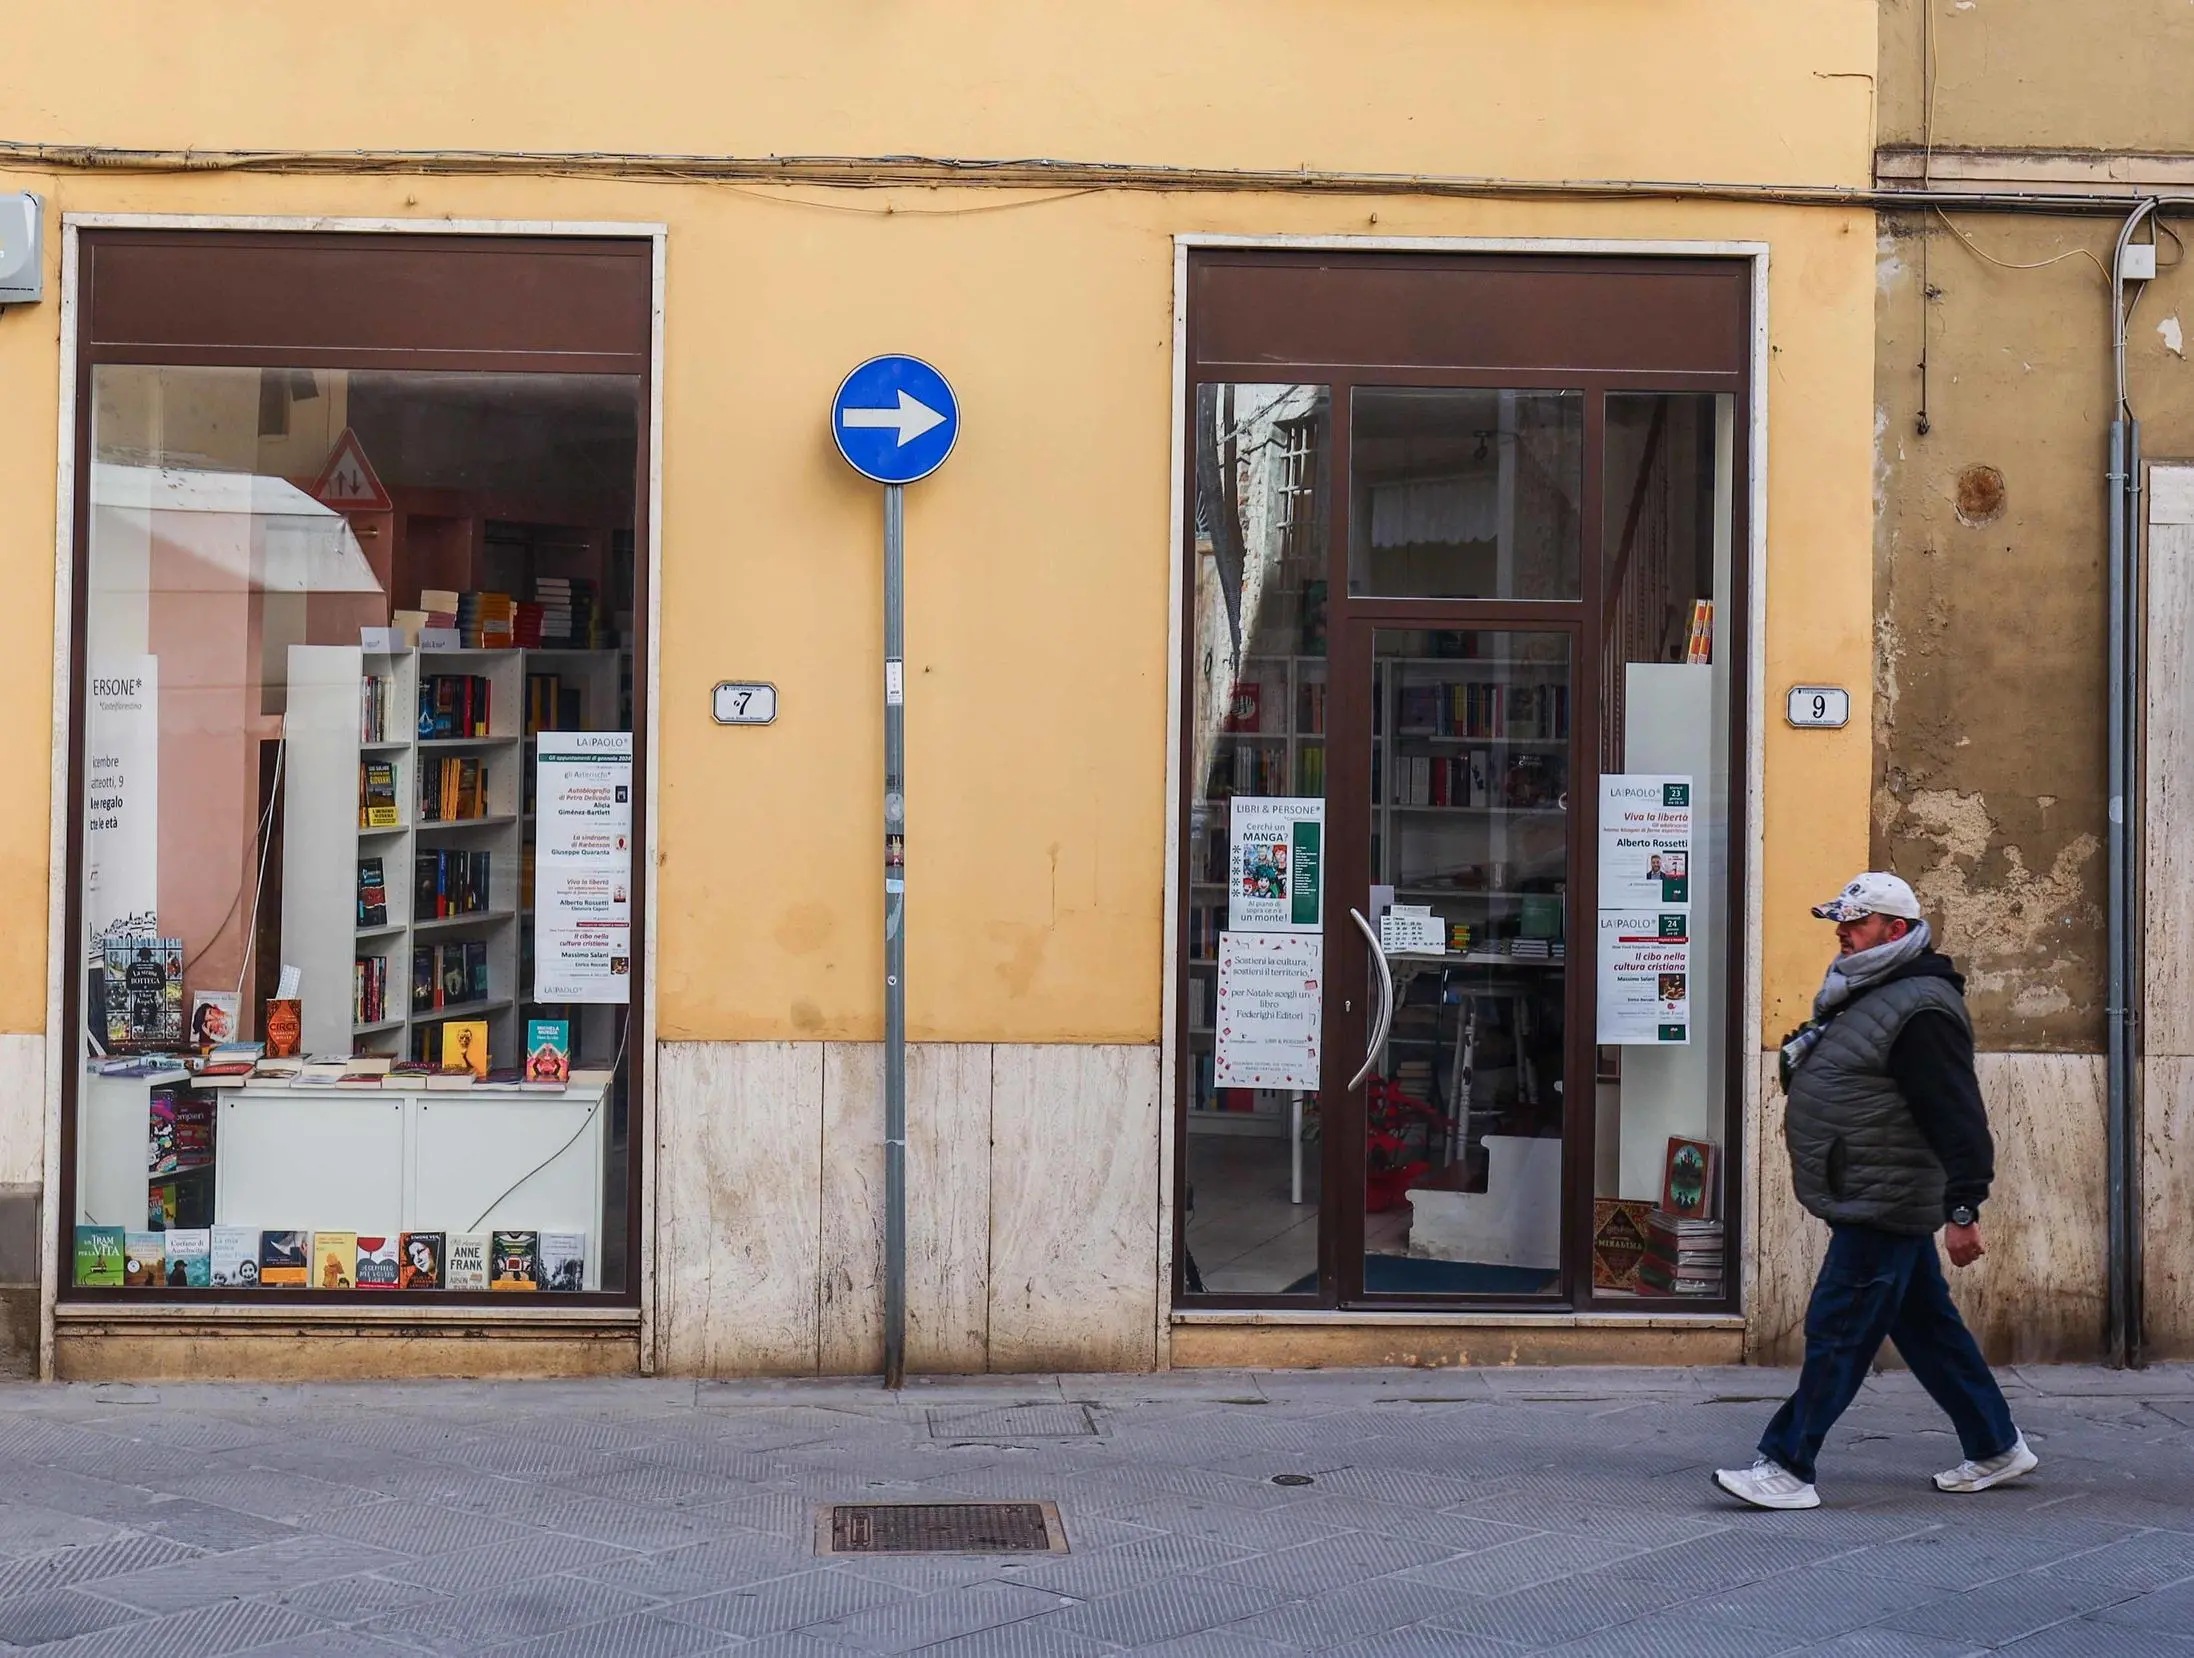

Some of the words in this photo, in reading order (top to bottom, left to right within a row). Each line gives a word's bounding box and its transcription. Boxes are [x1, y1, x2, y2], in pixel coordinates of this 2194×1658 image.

[739, 692, 753, 716] 7
[1812, 695, 1826, 719] 9
[119, 775, 124, 788] 9
[1236, 804, 1260, 814] LIBRI
[1261, 804, 1269, 814] &
[1624, 812, 1645, 822] Viva
[1646, 812, 1656, 822] la
[1657, 812, 1689, 822] libertà
[105, 816, 118, 829] età
[1246, 822, 1273, 832] Cerchi
[1274, 824, 1286, 832] un
[1242, 833, 1289, 843] MANGA?
[1616, 838, 1651, 848] Alberto
[1652, 838, 1688, 848] Rossetti
[1240, 914, 1253, 923] un
[1254, 913, 1288, 923] monte!
[1667, 920, 1677, 928] 24
[1234, 956, 1266, 966] Sostieni
[1267, 956, 1276, 966] la
[1276, 956, 1309, 967] cultura,
[1635, 952, 1641, 961] Il
[1643, 952, 1662, 961] cibo
[1663, 952, 1686, 961] nella
[1232, 967, 1264, 977] sostieni
[1613, 962, 1646, 972] cultura
[1646, 962, 1687, 972] cristiana
[131, 977, 161, 985] BOTTEGA
[1231, 989, 1245, 999] per
[1246, 988, 1273, 998] Natale
[1273, 988, 1298, 999] scegli
[1298, 990, 1311, 999] un
[1259, 998, 1280, 1008] libro
[1275, 1010, 1304, 1020] Editori
[269, 1022, 299, 1032] CIRCE
[92, 1234, 115, 1246] TRAM
[93, 1244, 121, 1257] VITA
[453, 1246, 481, 1259] ANNE
[450, 1259, 483, 1271] FRANK
